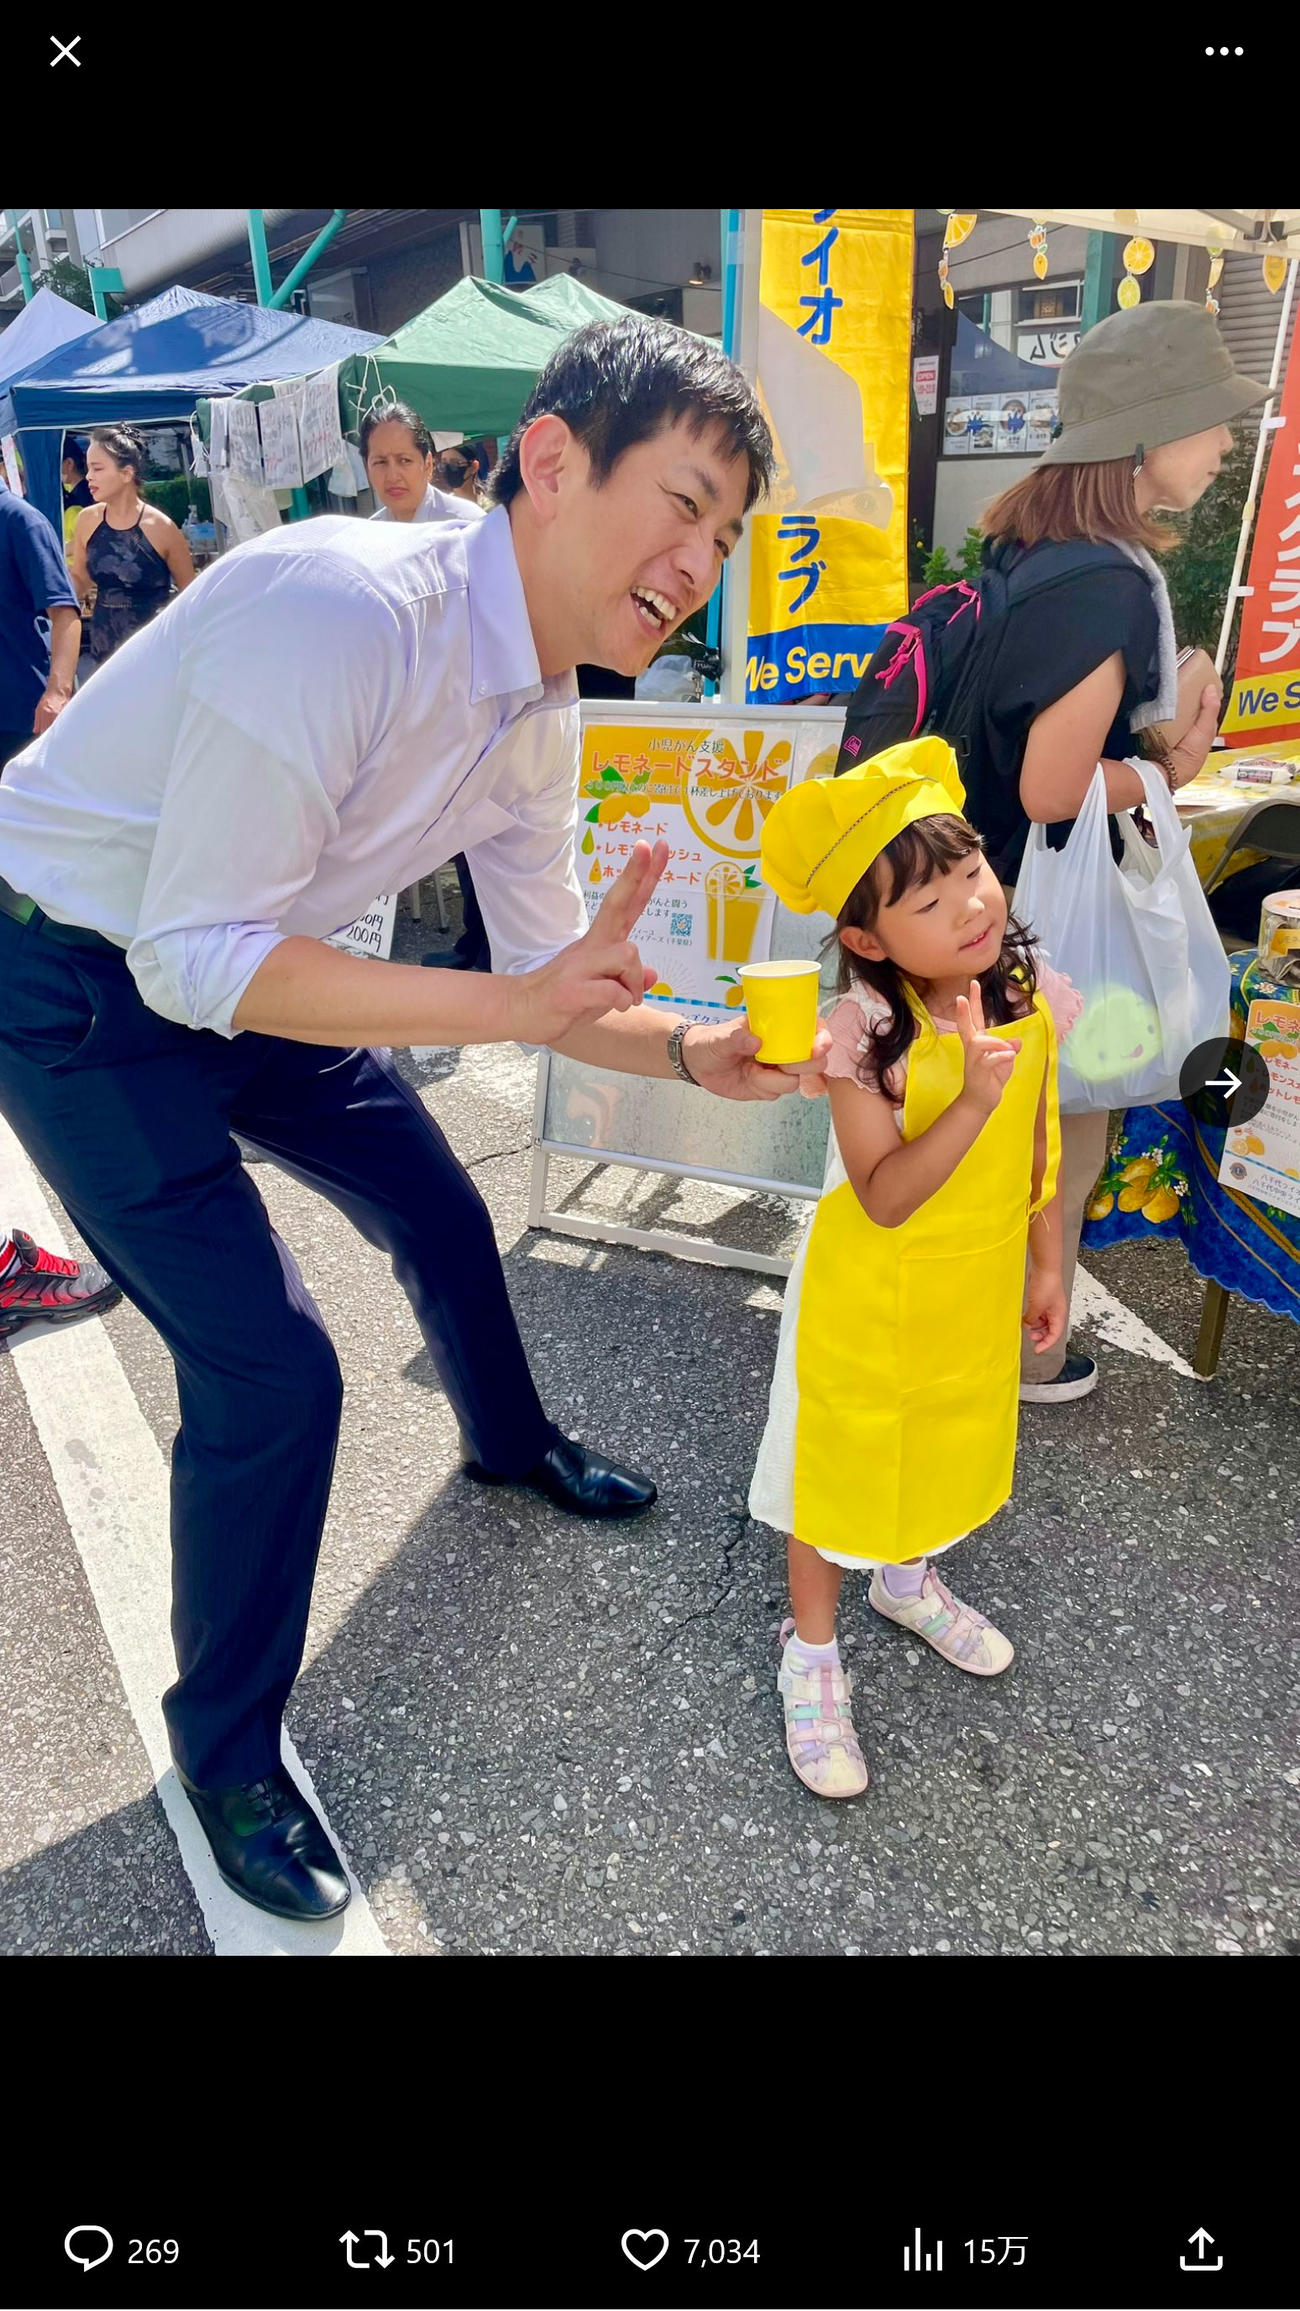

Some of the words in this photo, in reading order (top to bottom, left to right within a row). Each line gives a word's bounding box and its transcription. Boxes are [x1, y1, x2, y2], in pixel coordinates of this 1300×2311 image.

[777, 515, 827, 614] ラブ
[746, 656, 779, 691] We
[1238, 687, 1279, 717] We
[648, 738, 724, 754] 小児がん支援
[592, 751, 785, 782] レモネードスタンド
[607, 820, 669, 836] レモネード
